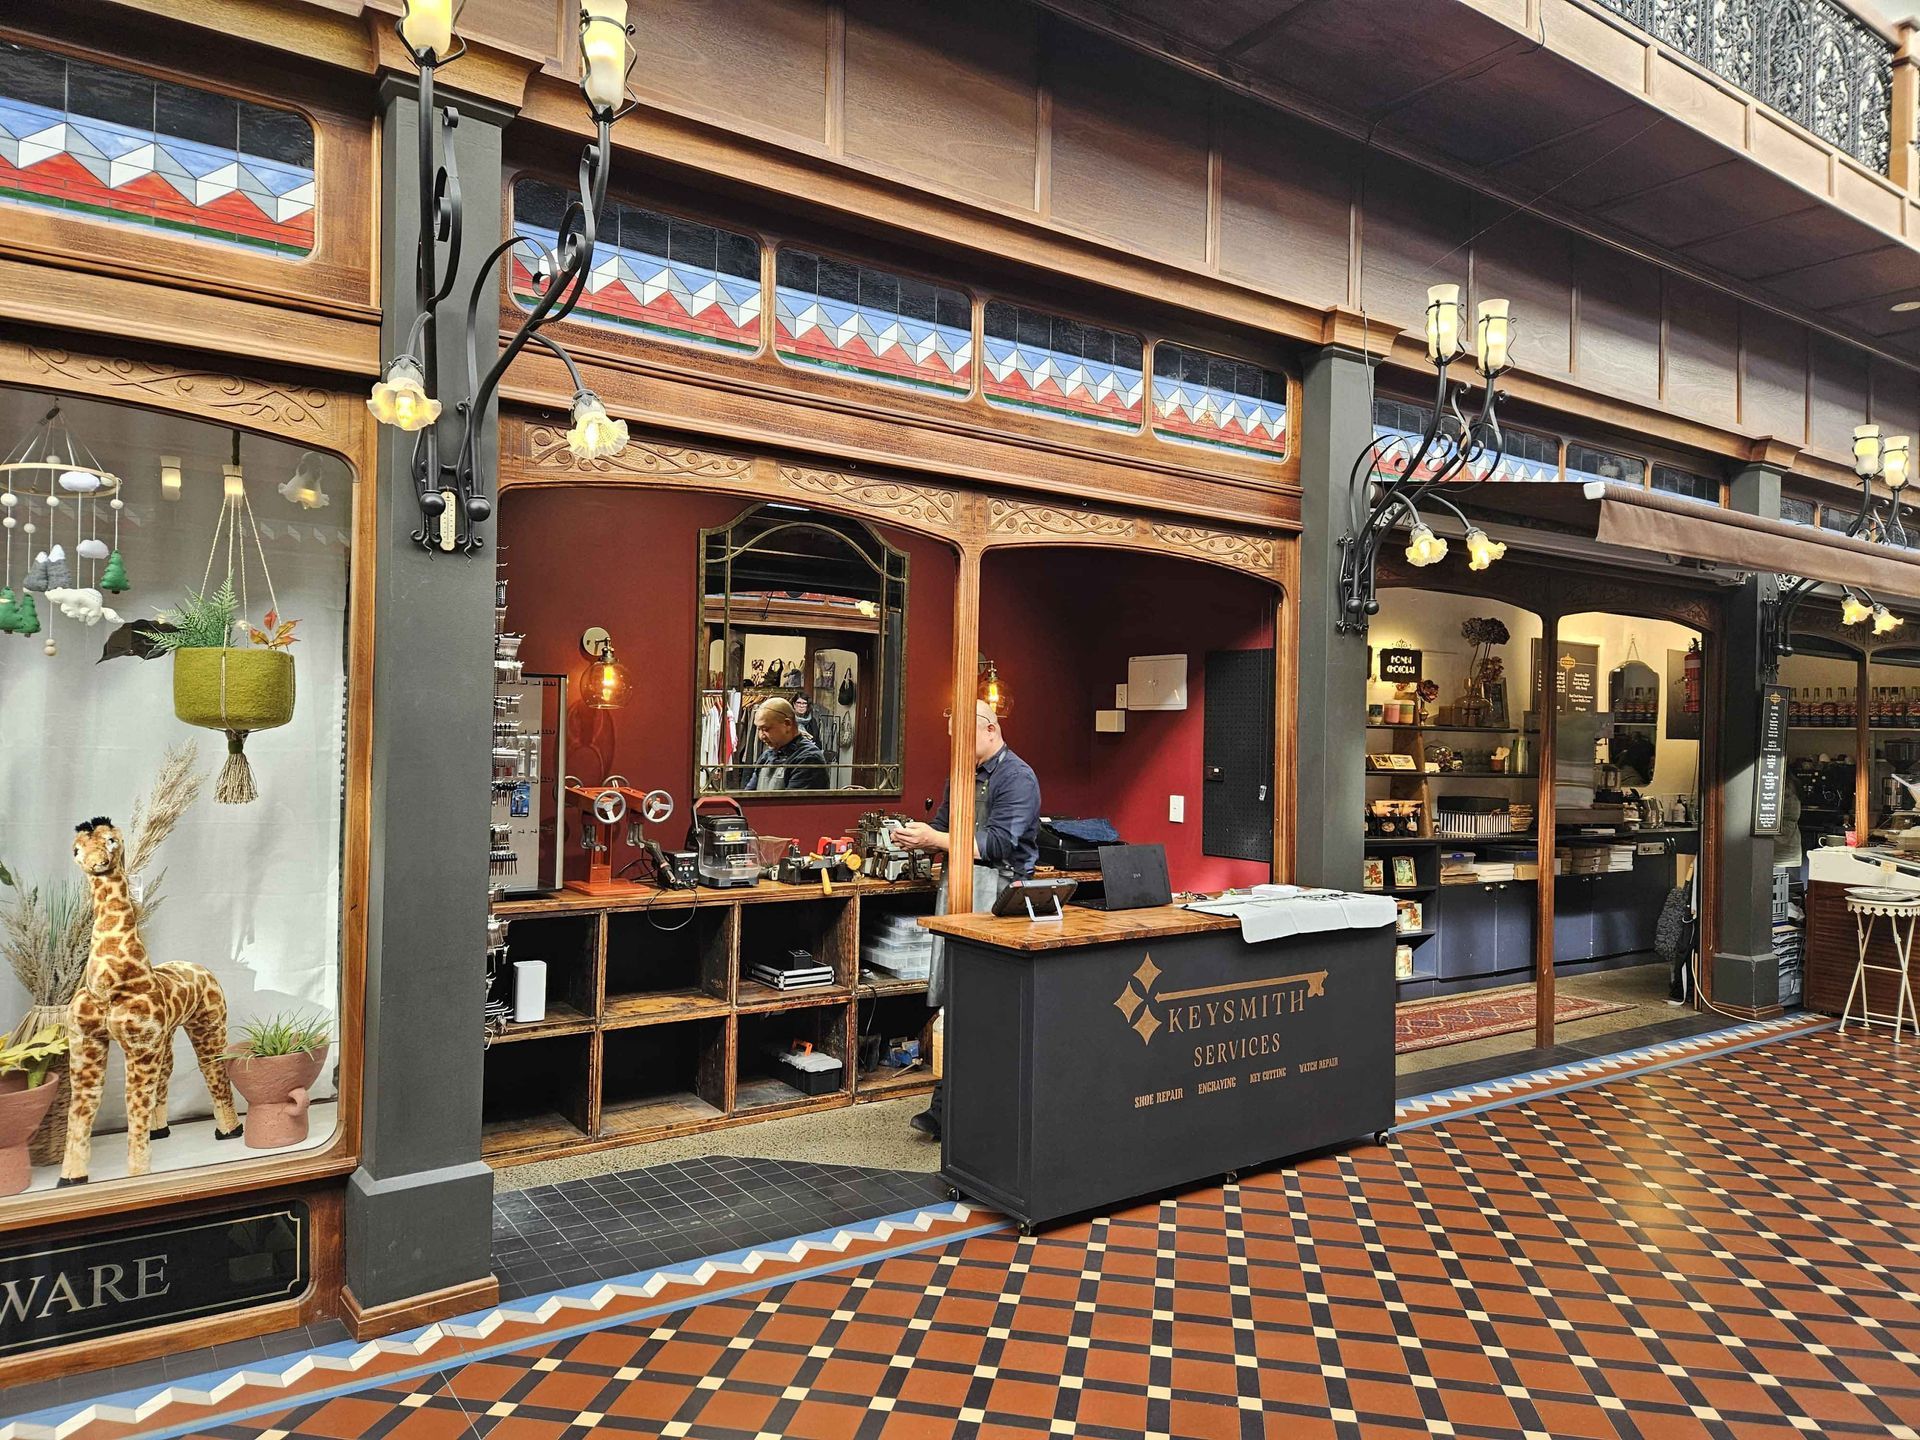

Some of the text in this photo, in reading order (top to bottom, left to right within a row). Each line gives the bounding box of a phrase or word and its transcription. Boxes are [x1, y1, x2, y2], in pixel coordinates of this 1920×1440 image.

[1168, 989, 1305, 1033] KEYSMITH
[1193, 1032, 1281, 1068] SERVICES
[1134, 1056, 1339, 1108] SHOE REPAIR ENGRAVING KEY CUTTING WATCH REPAIR
[0, 1254, 170, 1325] WARE
